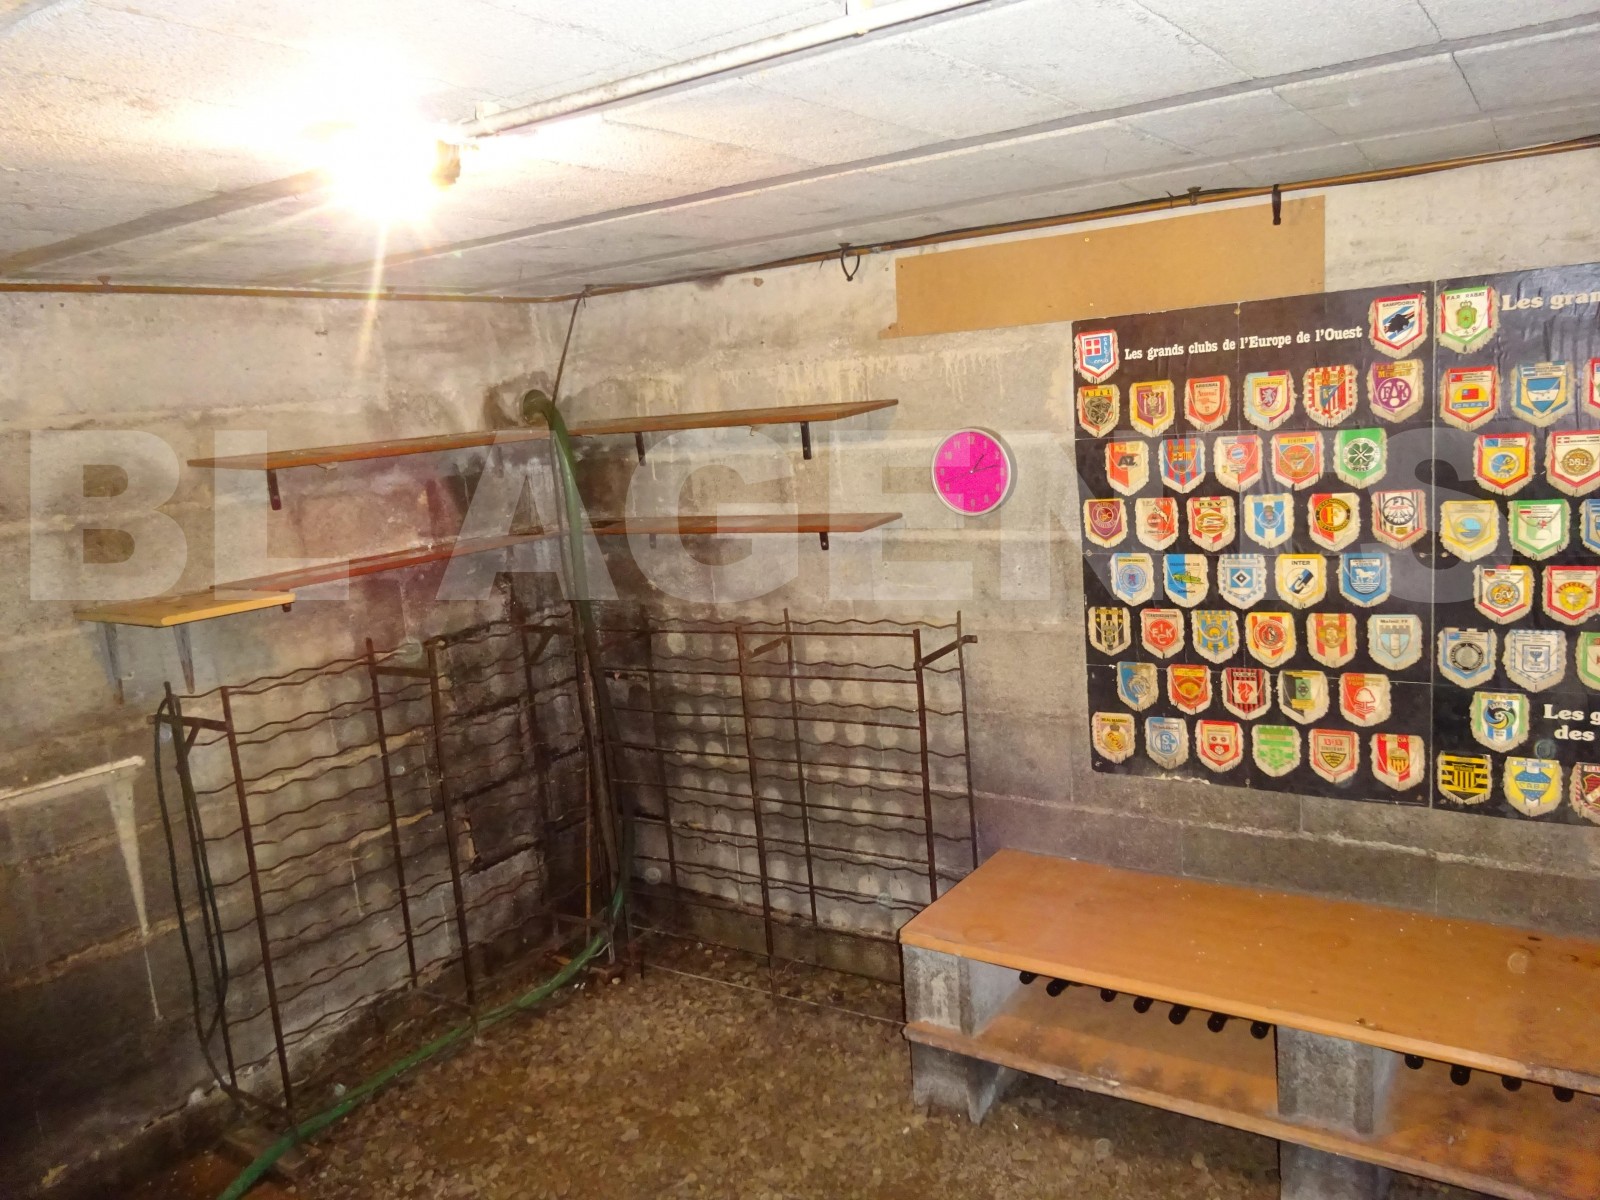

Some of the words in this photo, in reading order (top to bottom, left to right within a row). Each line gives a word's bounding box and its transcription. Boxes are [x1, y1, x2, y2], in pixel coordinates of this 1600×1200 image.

[1501, 294, 1544, 311] Les
[1124, 348, 1143, 360] Les
[1147, 343, 1184, 361] grands
[1188, 340, 1218, 354] clubs
[1222, 338, 1236, 351] de
[1239, 334, 1292, 350] l'Europe
[1296, 331, 1311, 344] de
[1315, 325, 1363, 342] l'Ouest
[1085, 389, 1112, 397] AJAX
[1543, 704, 1585, 721] Les
[1554, 725, 1595, 741] des
